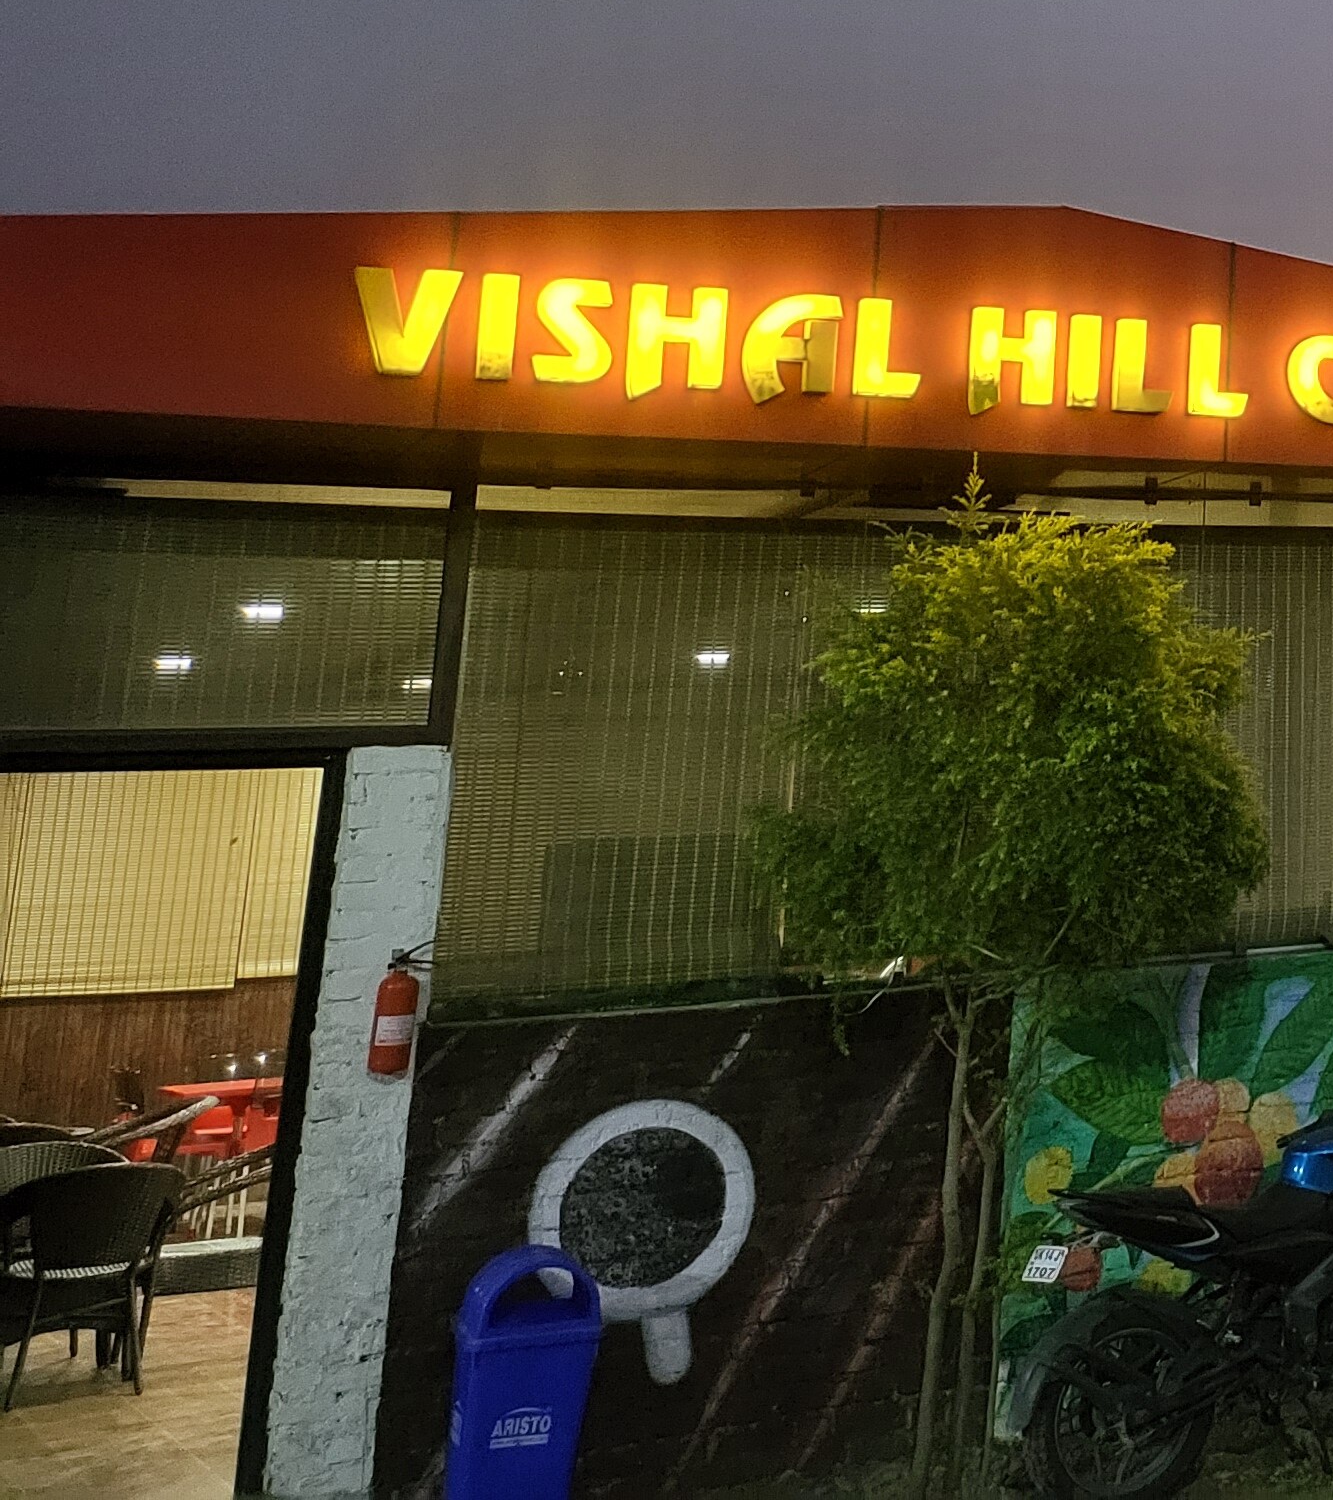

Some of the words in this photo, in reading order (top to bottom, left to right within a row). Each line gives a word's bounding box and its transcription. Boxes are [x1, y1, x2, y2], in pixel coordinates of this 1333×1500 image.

[355, 266, 921, 404] VISHAL
[967, 306, 1249, 416] HILL
[1027, 1266, 1057, 1279] 1707
[490, 1414, 552, 1437] ARISTO
